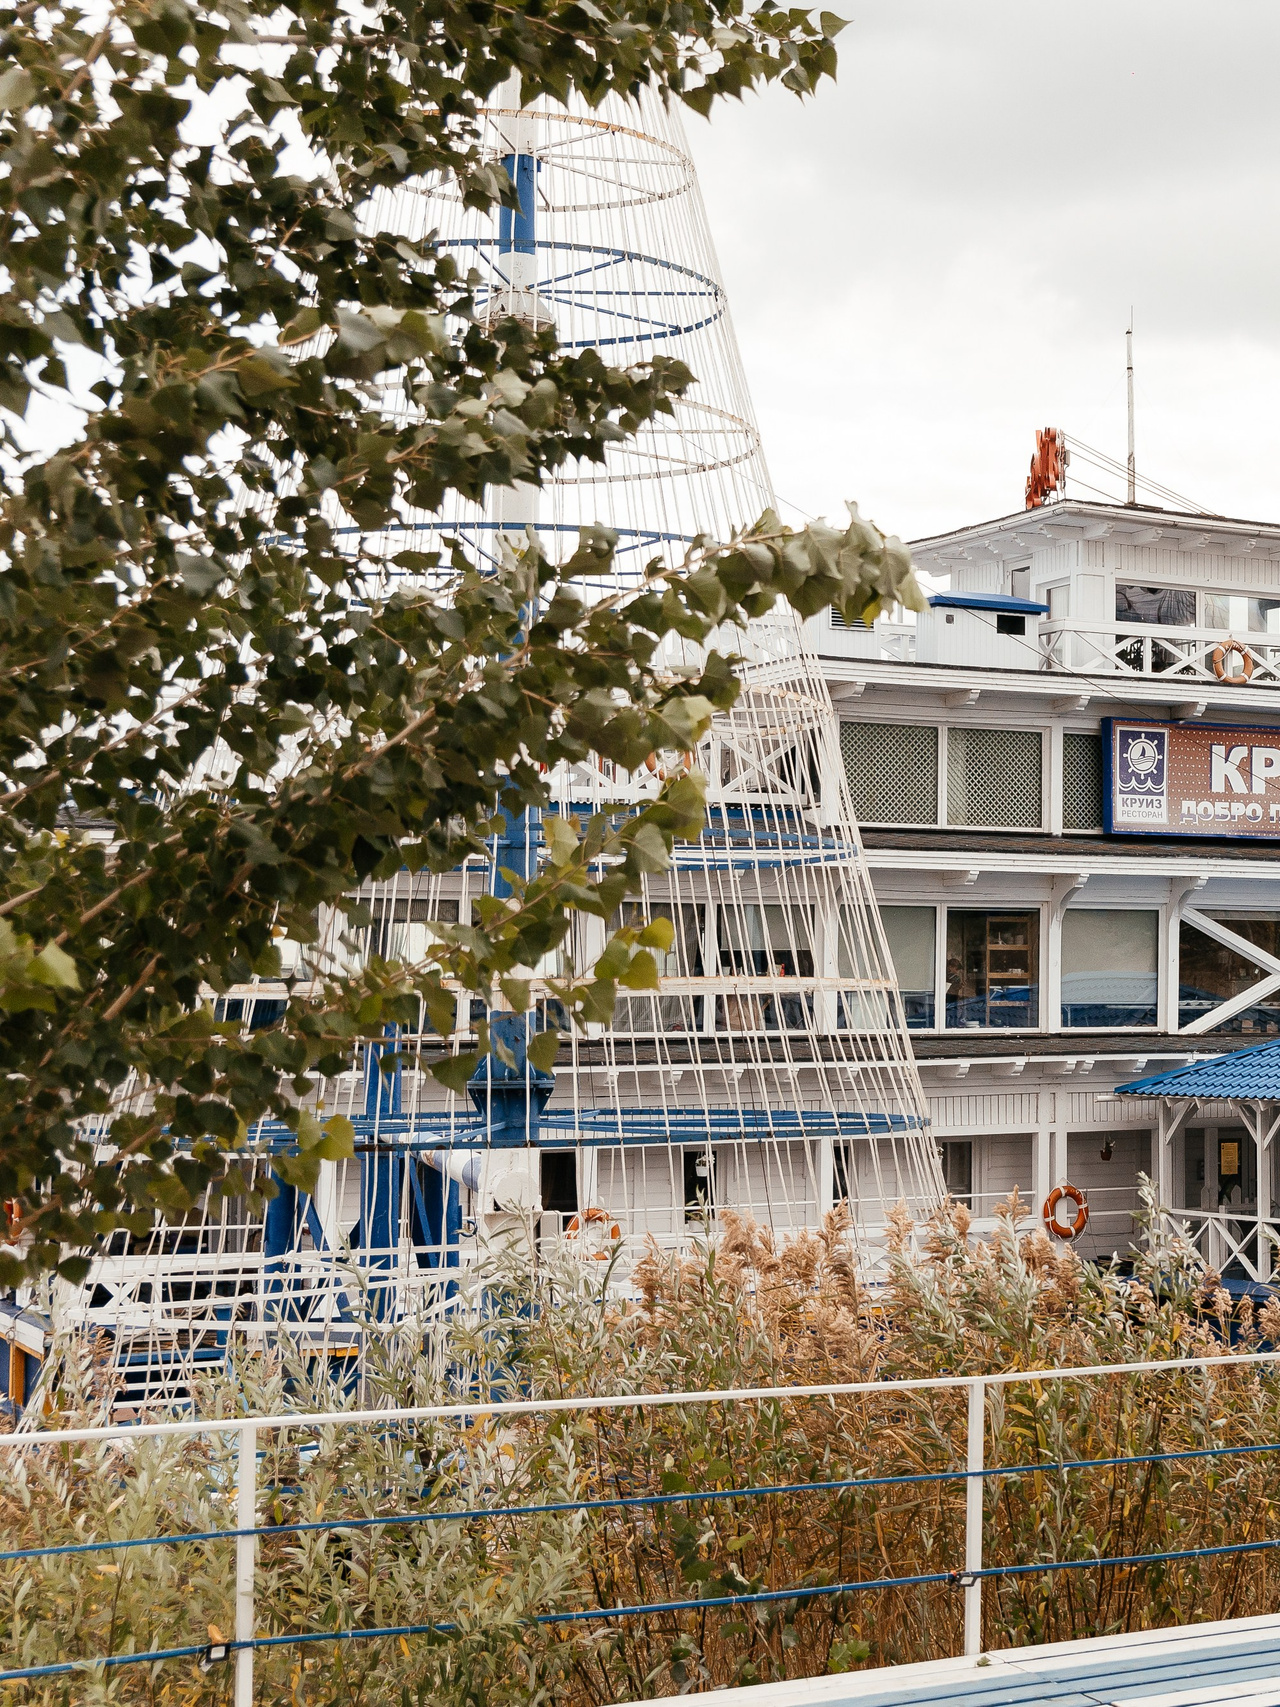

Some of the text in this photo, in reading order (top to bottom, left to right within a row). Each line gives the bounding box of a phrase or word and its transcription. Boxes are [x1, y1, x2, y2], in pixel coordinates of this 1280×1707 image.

[1121, 797, 1162, 809] КРУИЗ
[1121, 810, 1163, 819] РЕСТОРАН
[1179, 800, 1263, 825] ДОБРО
